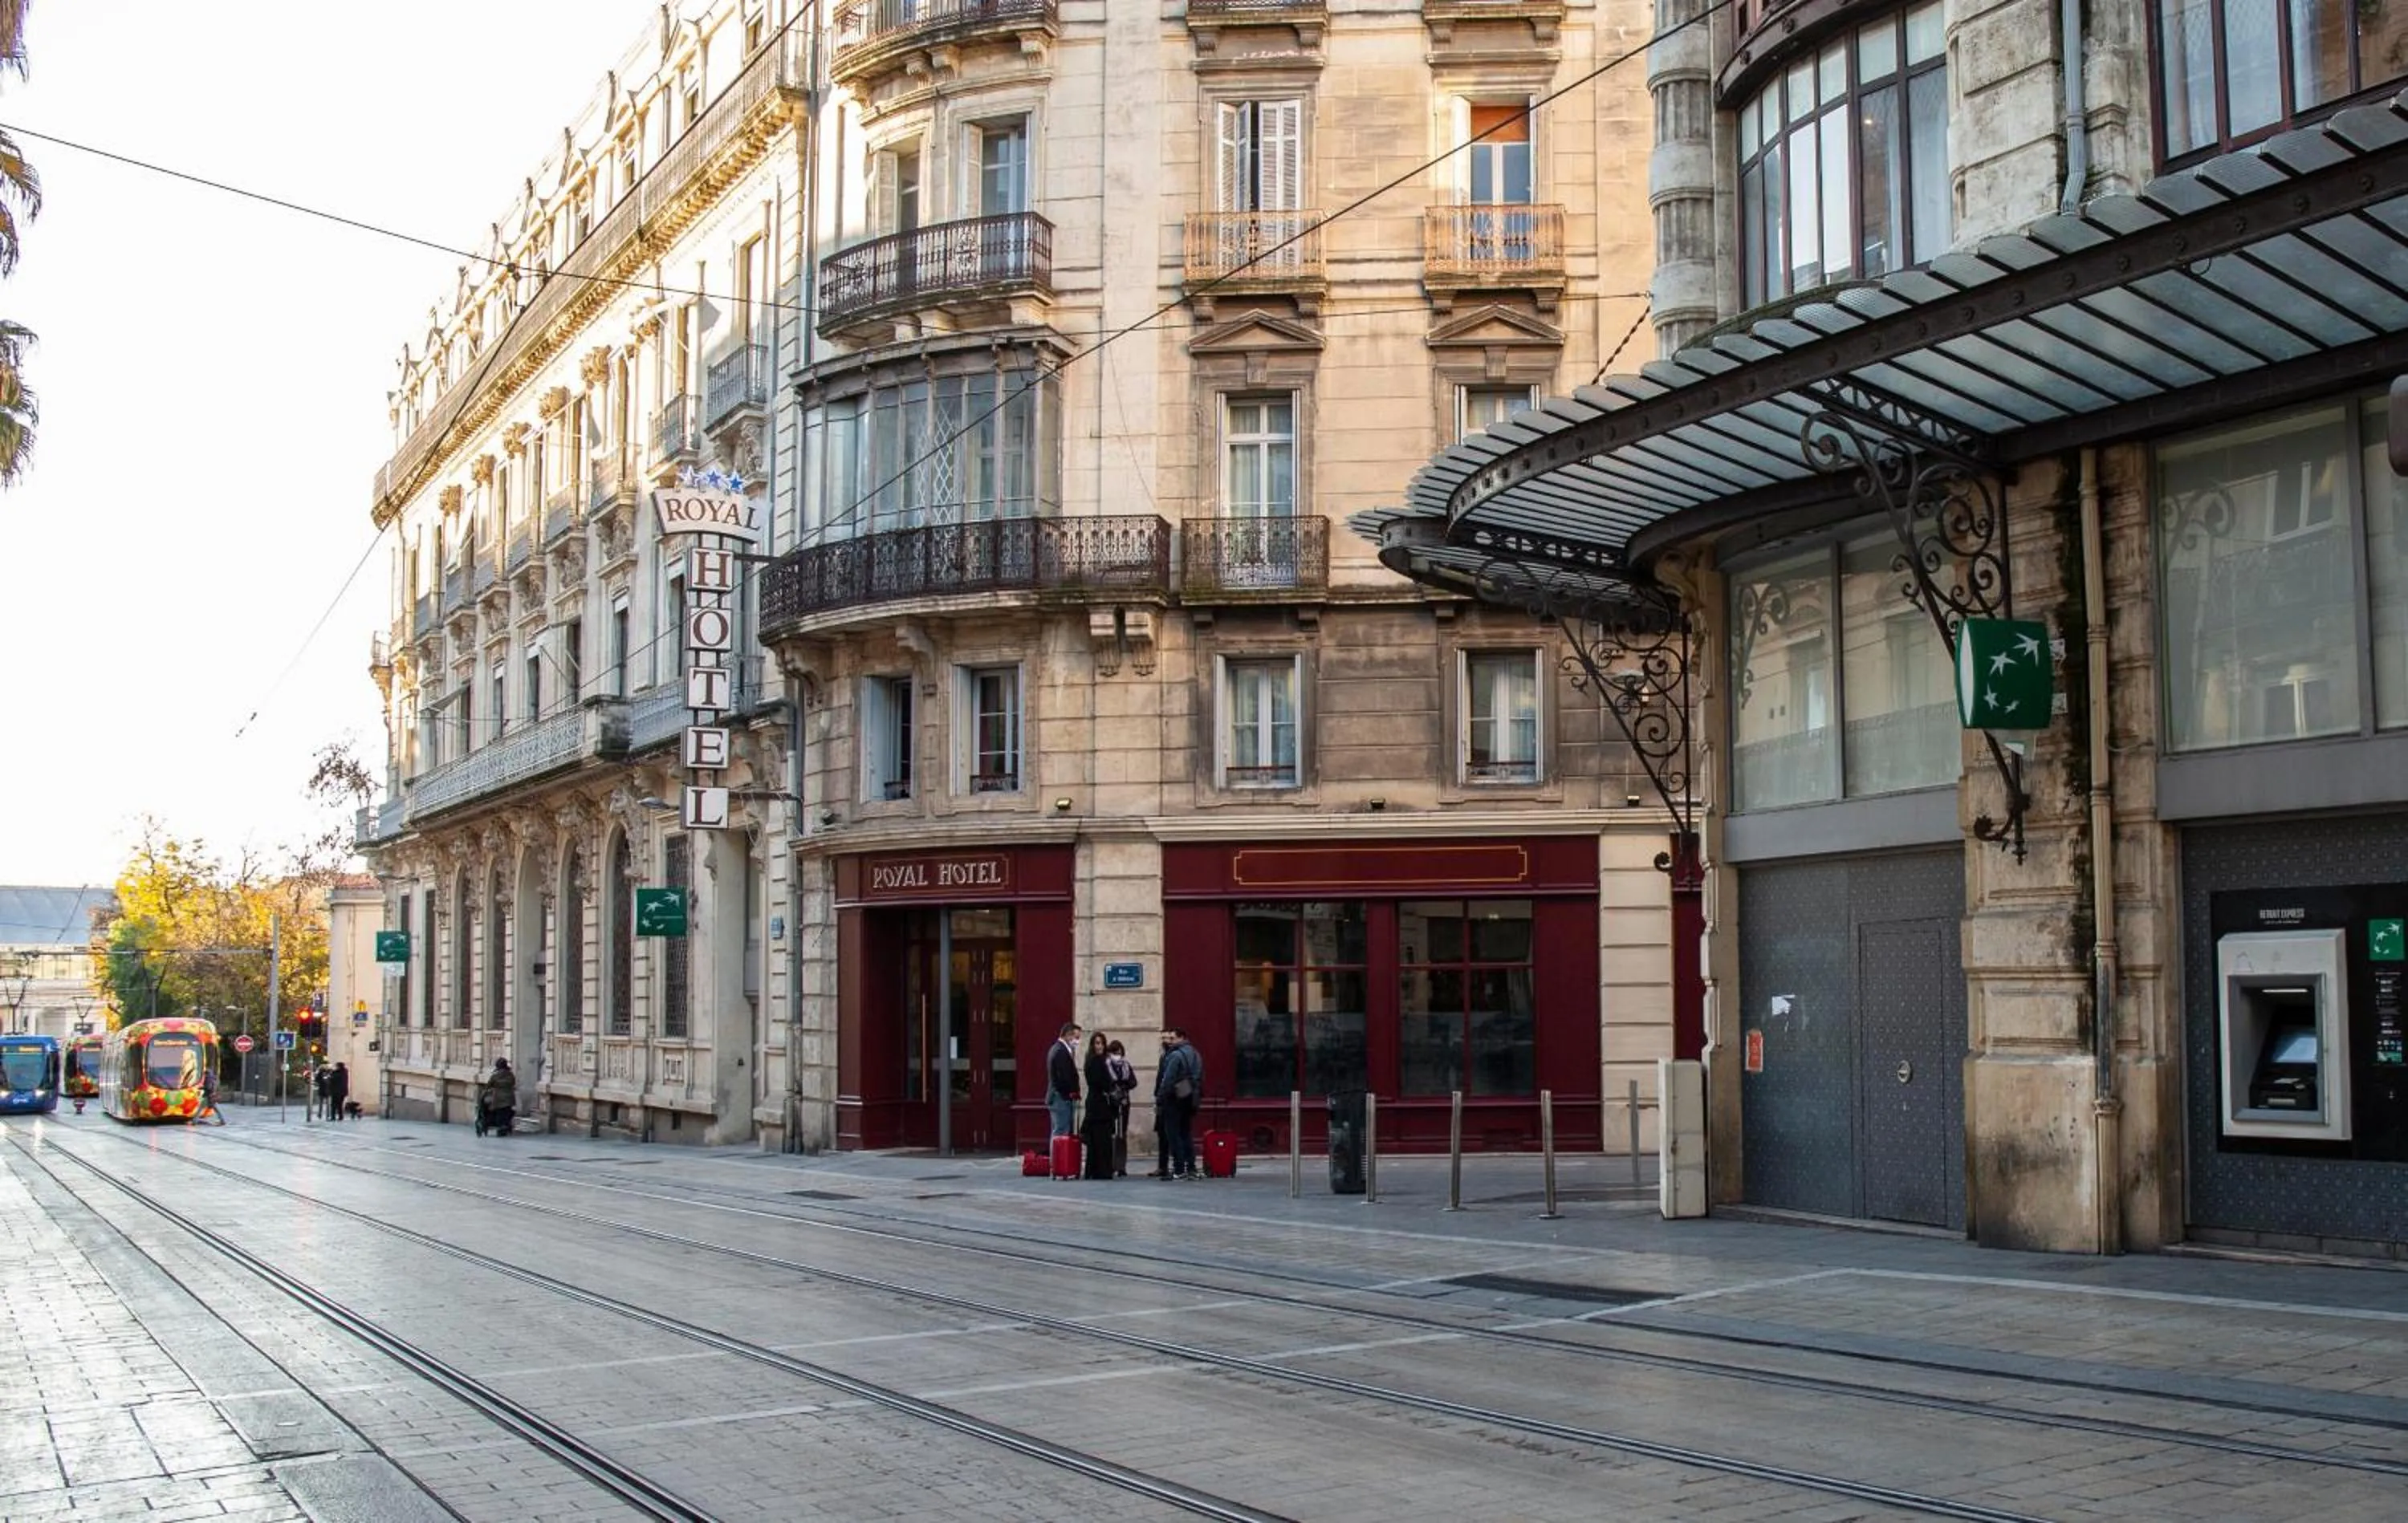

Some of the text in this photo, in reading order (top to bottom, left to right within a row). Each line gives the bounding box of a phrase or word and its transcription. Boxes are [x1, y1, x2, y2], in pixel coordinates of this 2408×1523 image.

[664, 497, 761, 531] ROYAL
[689, 550, 730, 826] HOTEL
[872, 861, 1002, 888] ROYAL HOTEL
